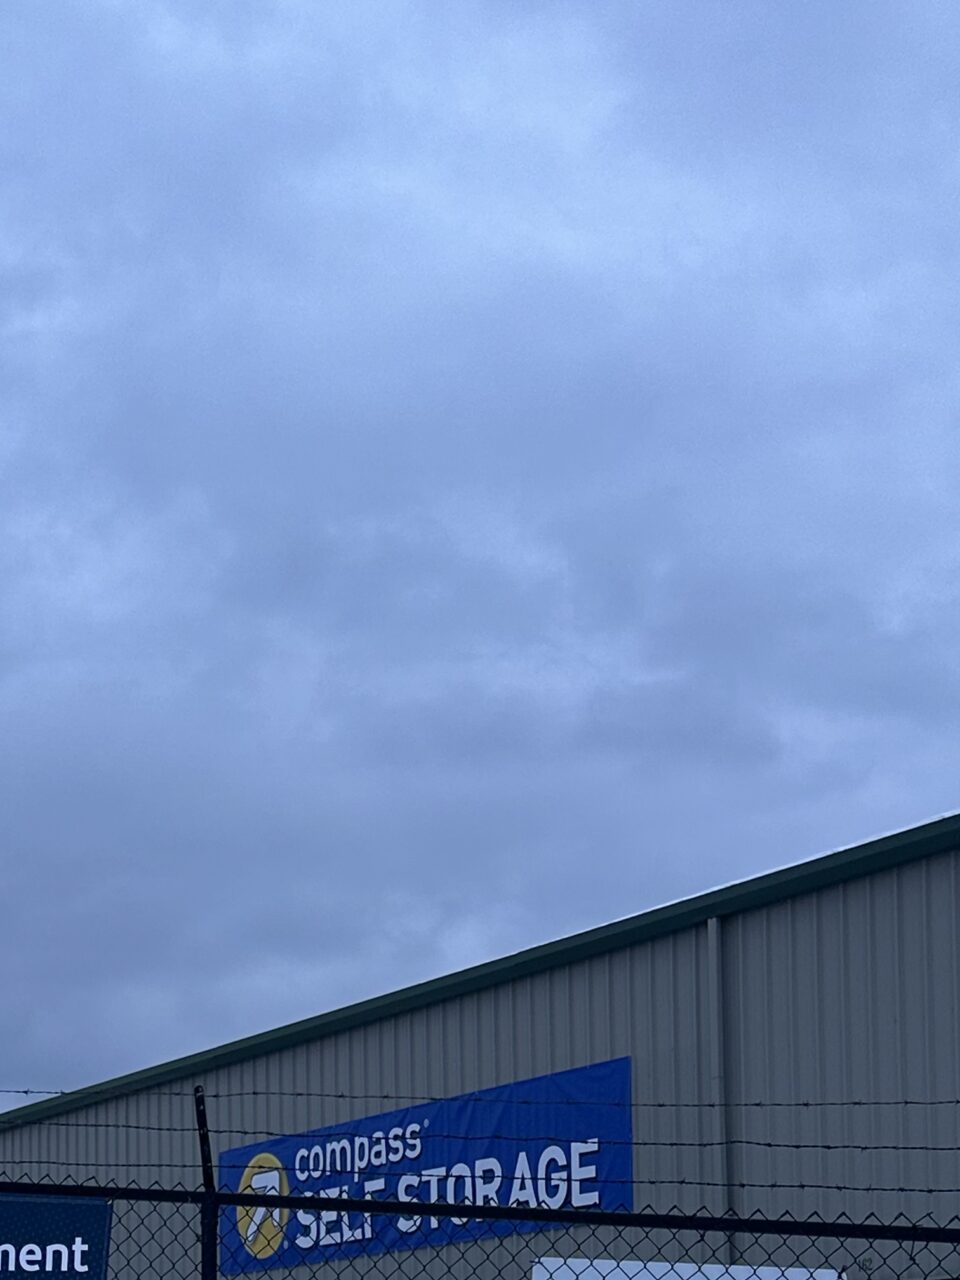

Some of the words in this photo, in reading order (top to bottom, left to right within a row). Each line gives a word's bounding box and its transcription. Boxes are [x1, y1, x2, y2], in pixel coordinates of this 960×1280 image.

[294, 1122, 422, 1183] compass
[294, 1177, 386, 1249] SELF
[396, 1137, 600, 1233] STORAGE
